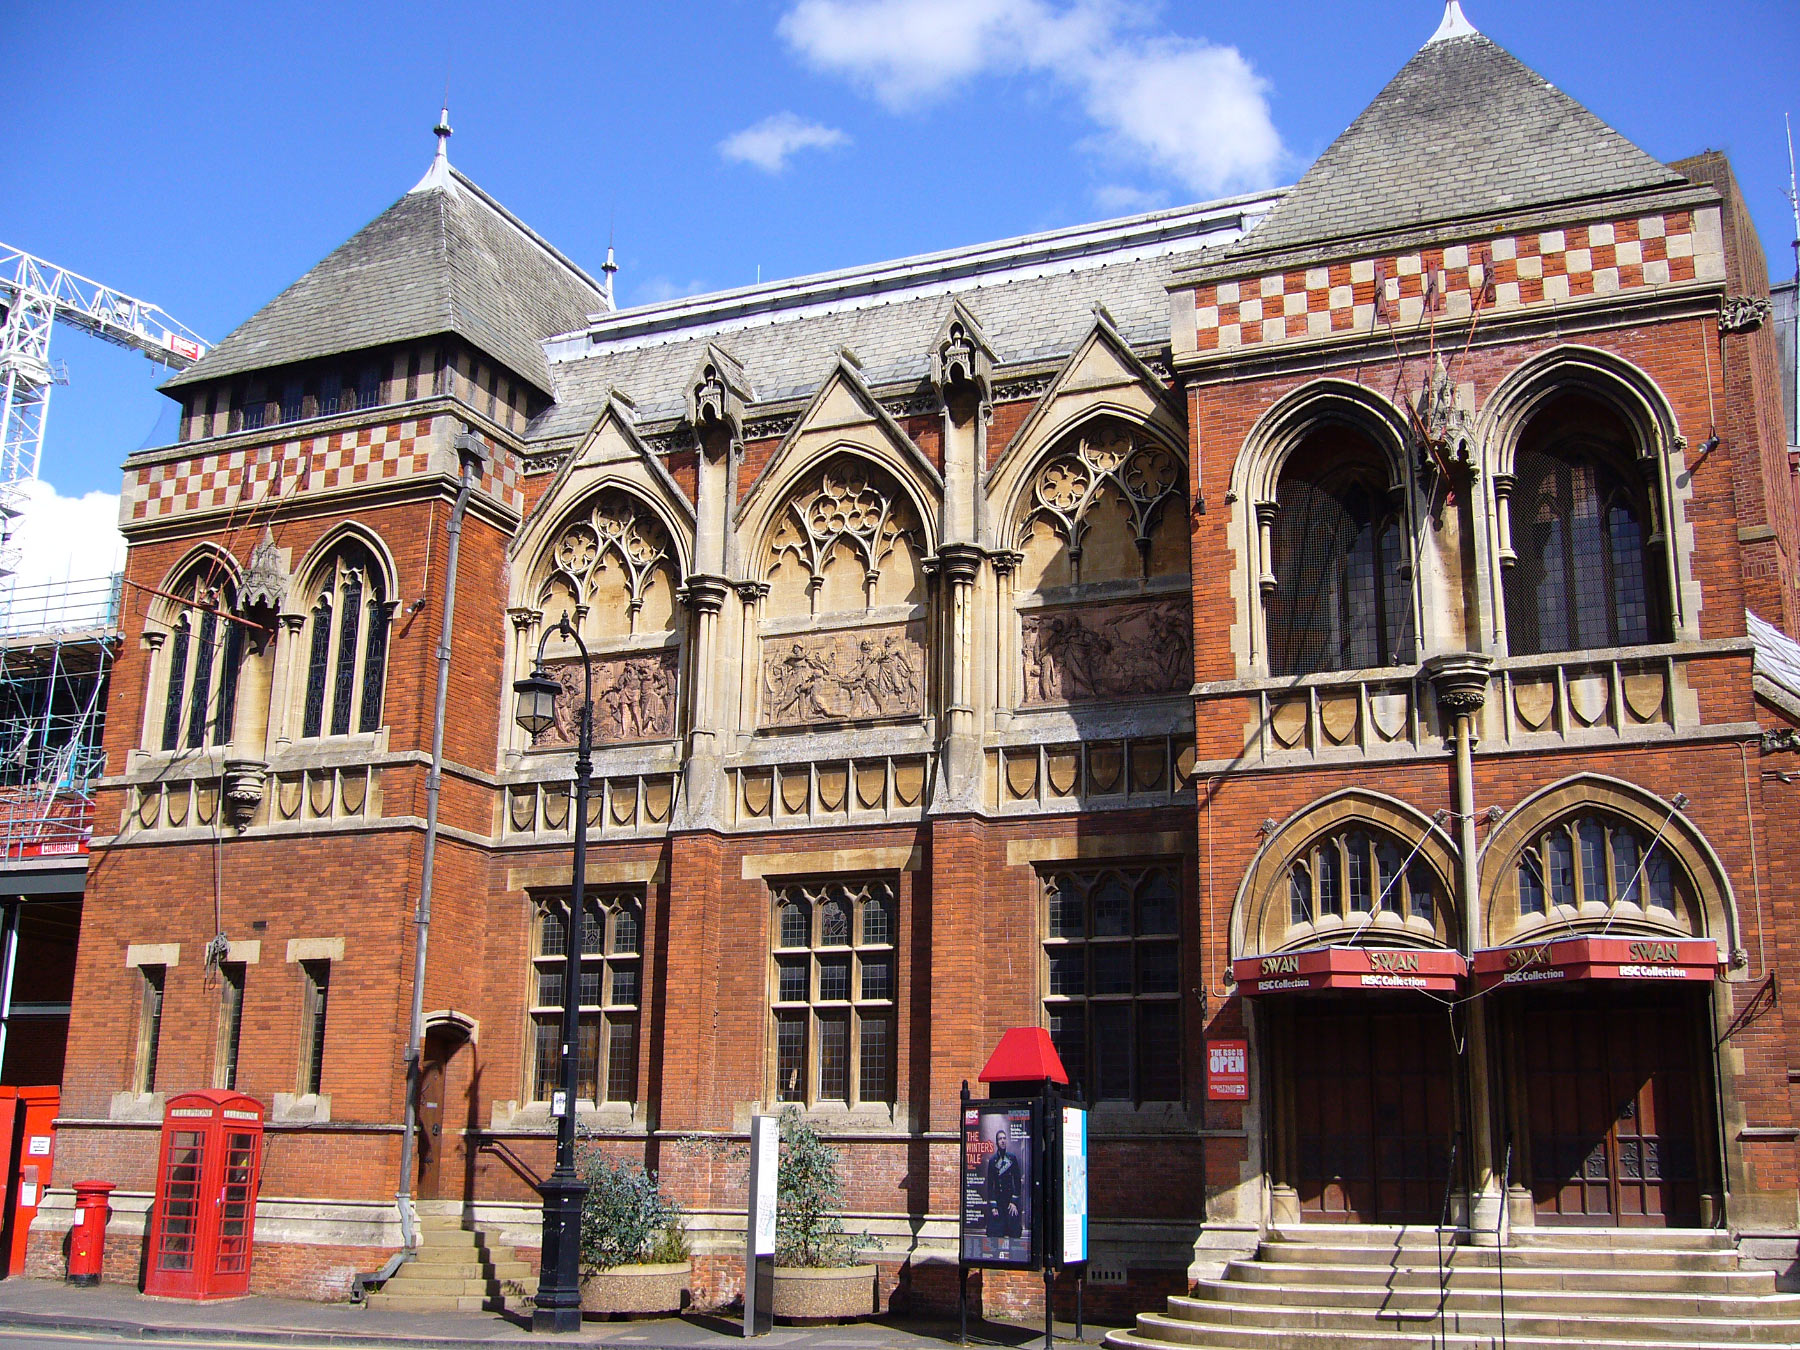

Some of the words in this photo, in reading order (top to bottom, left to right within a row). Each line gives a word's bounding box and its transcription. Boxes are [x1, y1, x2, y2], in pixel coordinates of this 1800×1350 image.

[43, 843, 76, 853] COMBISAFE
[1508, 945, 1552, 967] SWAN
[1629, 943, 1678, 962] SWAN
[1262, 956, 1299, 975] SWAN
[1371, 953, 1418, 971] SWAN
[1504, 973, 1522, 983] RSC
[1523, 969, 1564, 980] Collection
[1619, 966, 1640, 976] RSC
[1641, 966, 1686, 977] Collection
[1258, 980, 1274, 991] RSC
[1274, 978, 1310, 989] Collection
[1361, 975, 1382, 985] RSC
[1382, 975, 1427, 987] Collection
[1210, 1048, 1223, 1056] THE
[1223, 1048, 1236, 1056] RSC
[1236, 1048, 1244, 1056] IS
[1210, 1056, 1245, 1073] OPEN
[173, 1109, 211, 1117] TELEPHONE
[225, 1111, 257, 1120] TELEPHONE
[966, 1110, 979, 1119] RSC
[966, 1131, 980, 1142] THE
[966, 1140, 994, 1153] WINTER'S
[966, 1153, 982, 1164] TALE
